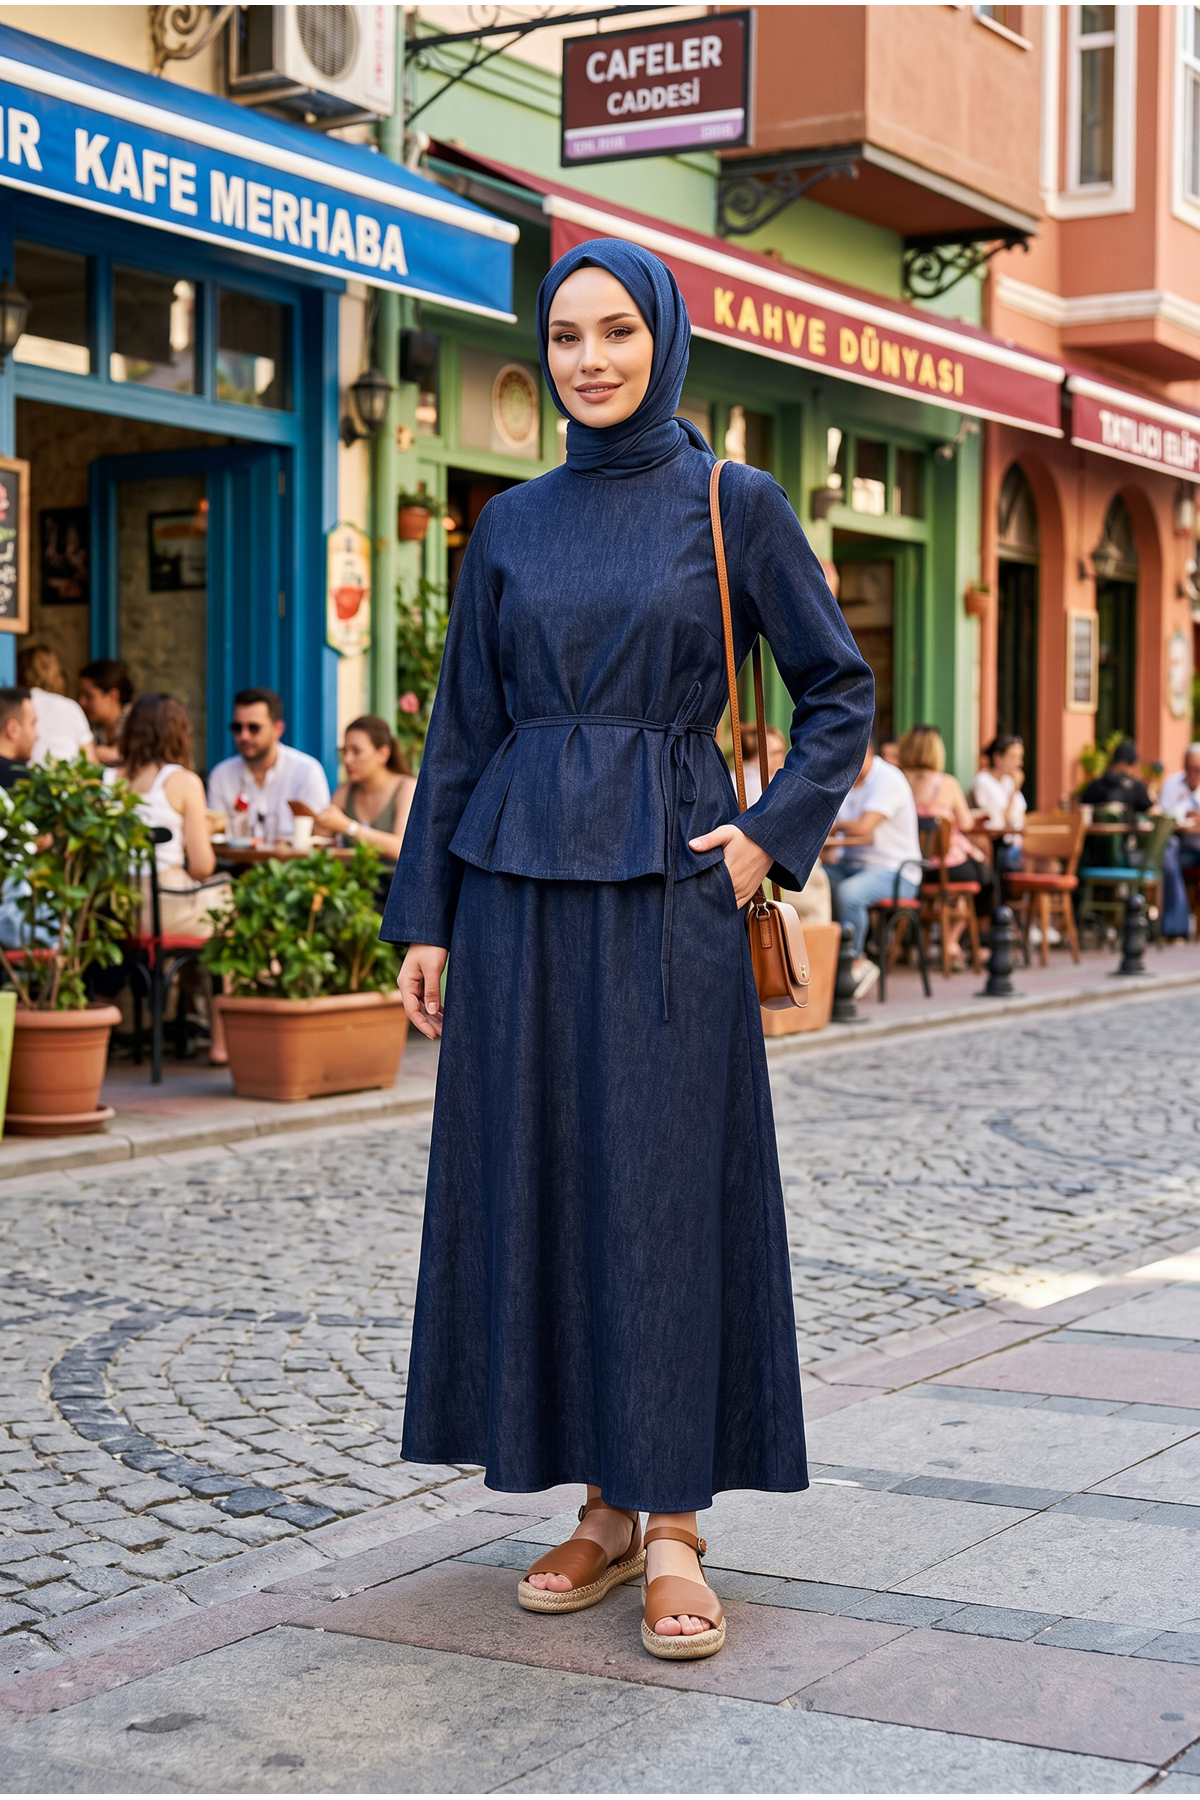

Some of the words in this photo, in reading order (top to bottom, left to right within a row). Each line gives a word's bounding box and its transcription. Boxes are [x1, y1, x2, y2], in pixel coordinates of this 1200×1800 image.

[586, 35, 723, 84] CAFELER
[606, 76, 701, 116] CADDESİ
[75, 127, 198, 217] KAFE
[210, 169, 409, 277] MERHABA
[714, 286, 826, 357] KAHVE
[839, 325, 964, 397] DÜNYASI
